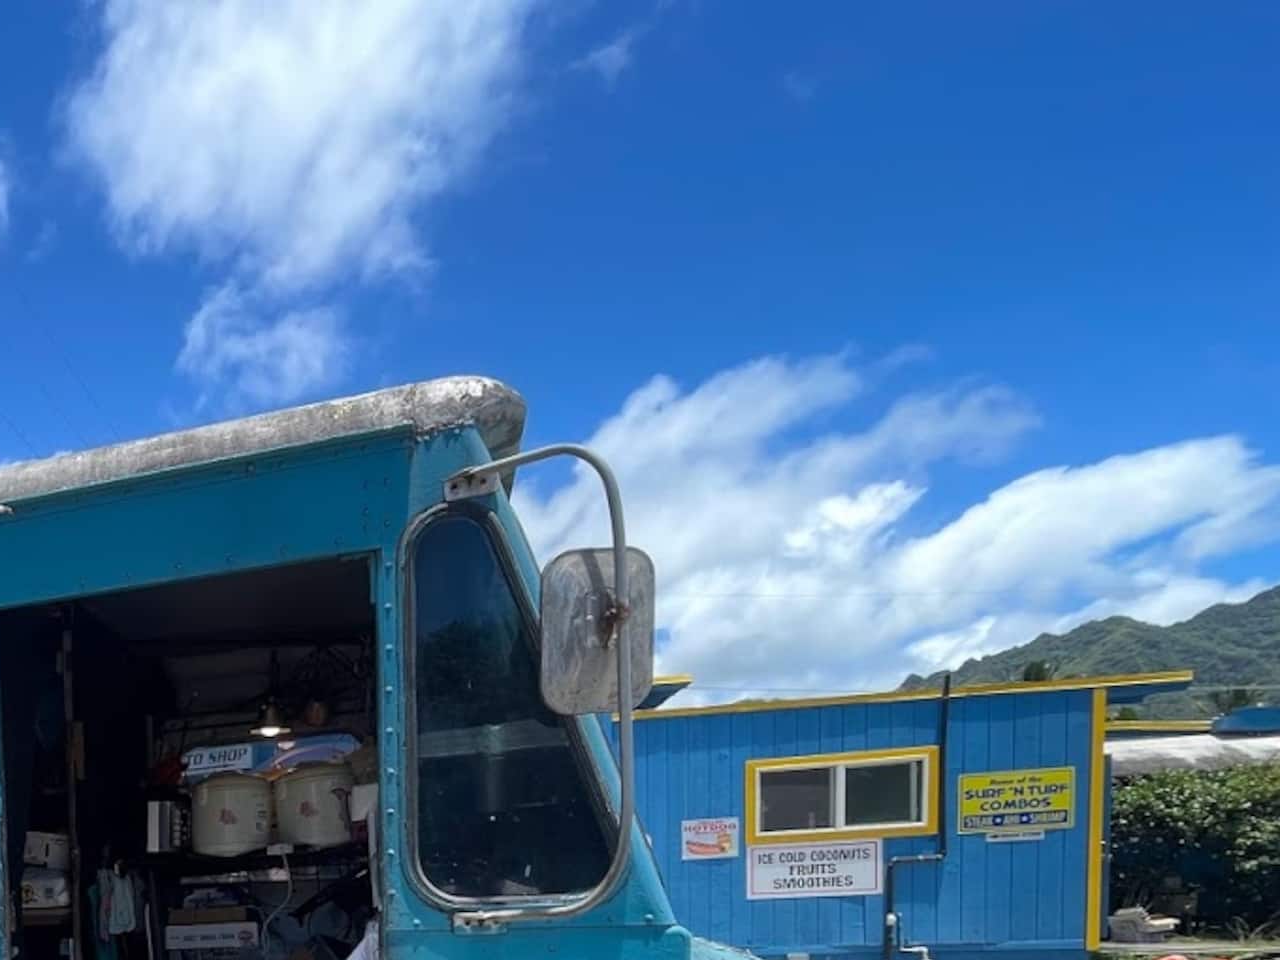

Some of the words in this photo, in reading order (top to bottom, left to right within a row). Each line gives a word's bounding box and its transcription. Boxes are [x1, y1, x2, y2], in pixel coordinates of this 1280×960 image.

[208, 748, 247, 762] SHOP
[964, 788, 1005, 800] SURF
[1028, 783, 1068, 796] TURF
[980, 797, 1051, 811] COMBOS
[758, 853, 774, 864] ICE
[779, 850, 807, 863] COLD
[811, 848, 870, 861] COCONUTS
[789, 863, 837, 876] FRUITS
[773, 875, 854, 890] SMOOTHIES
